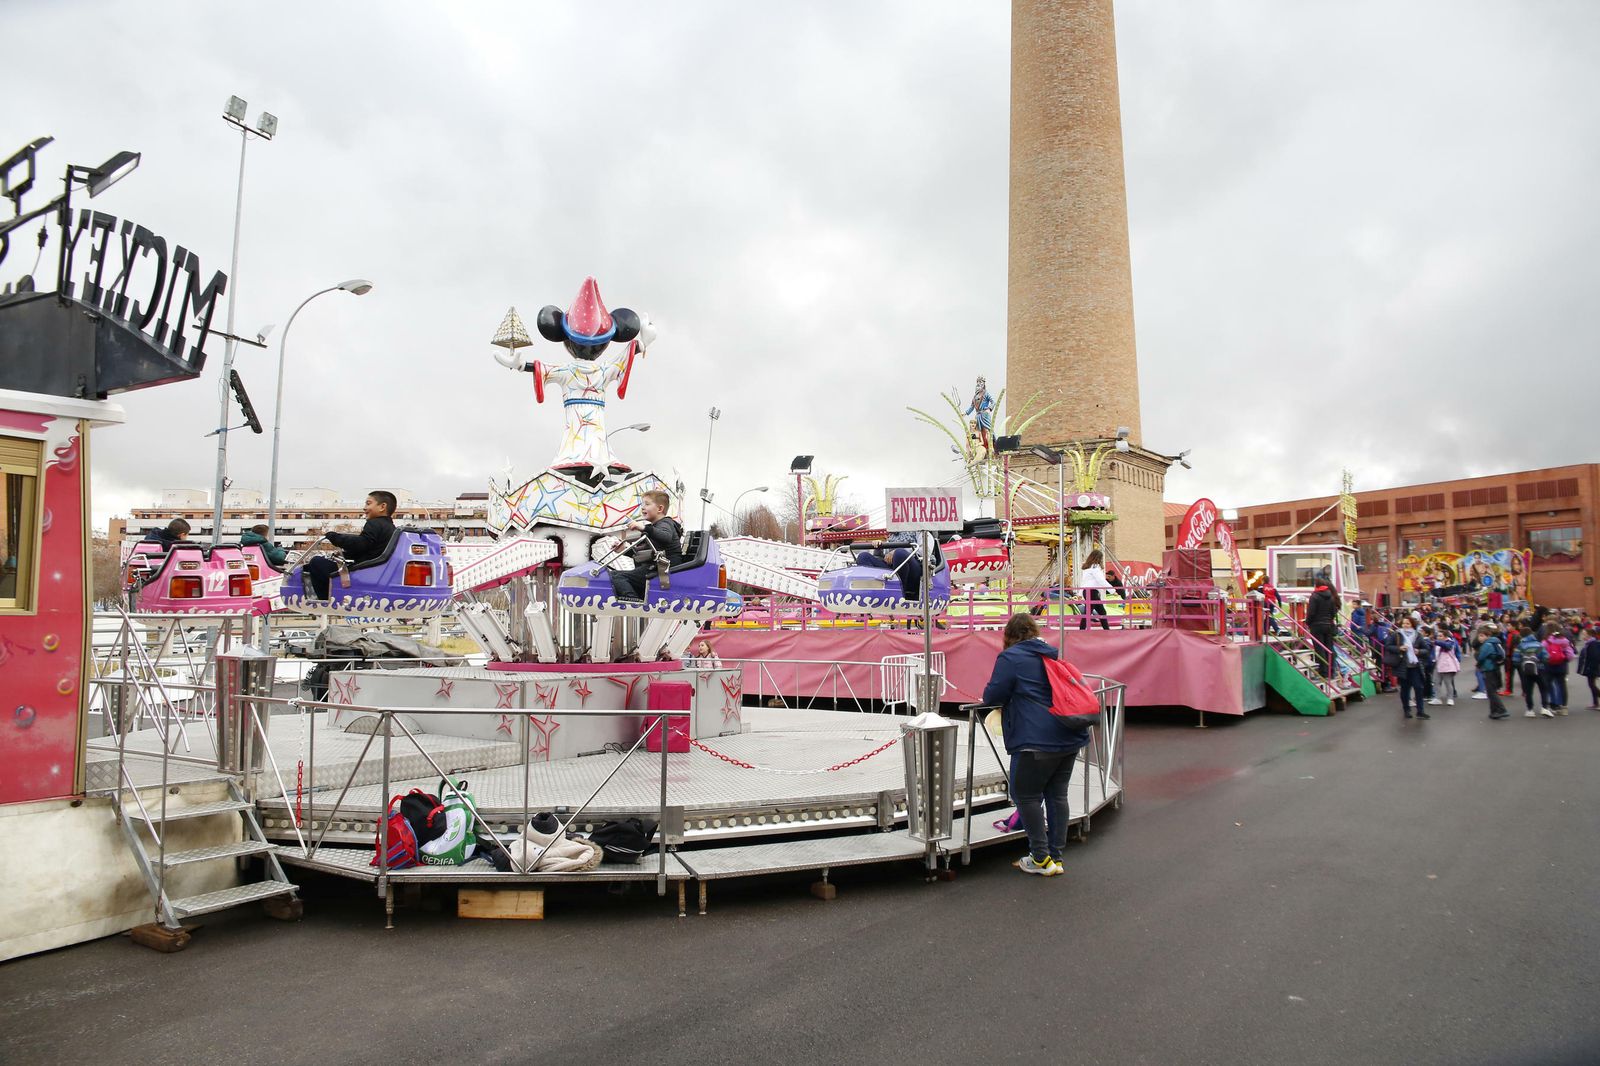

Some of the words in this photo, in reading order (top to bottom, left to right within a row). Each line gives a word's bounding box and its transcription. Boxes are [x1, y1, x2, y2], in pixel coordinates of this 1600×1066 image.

[891, 497, 959, 523] ENTRADA
[438, 558, 445, 580] 1
[207, 571, 225, 592] 12
